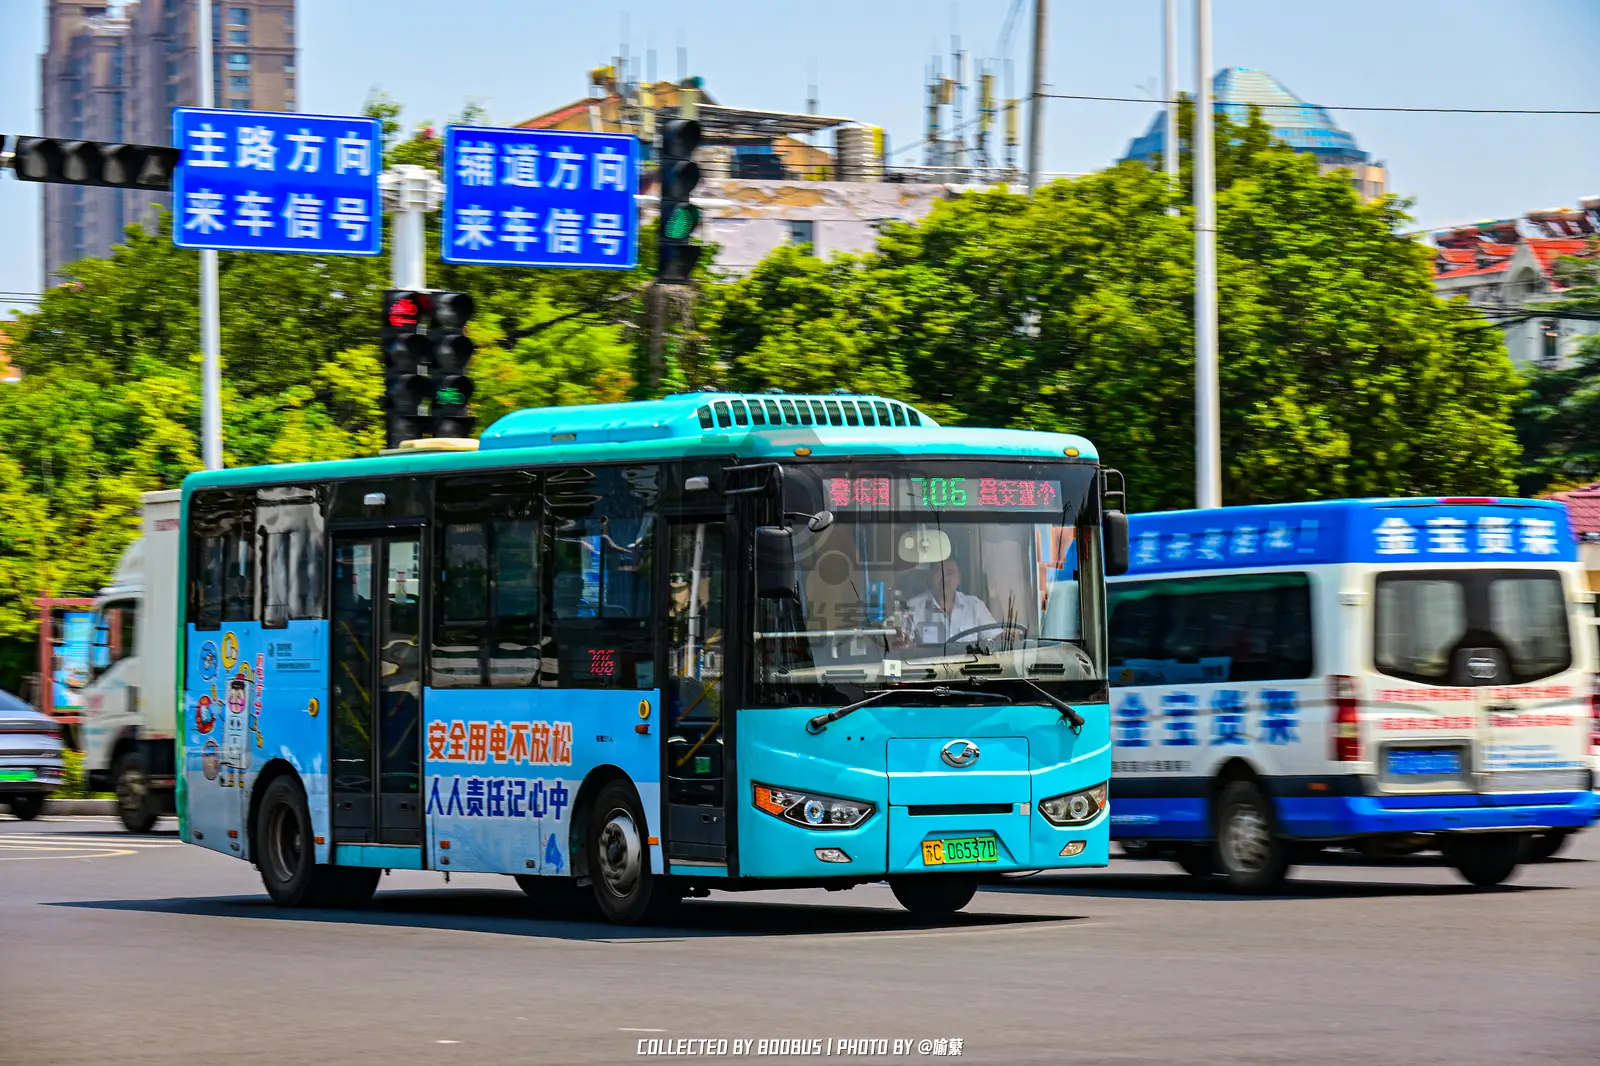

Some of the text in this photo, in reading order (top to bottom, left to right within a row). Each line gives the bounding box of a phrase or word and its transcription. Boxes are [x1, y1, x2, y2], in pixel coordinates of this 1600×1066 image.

[187, 124, 371, 176] 主路方向
[456, 140, 627, 192] 辅道方向
[184, 188, 371, 242] 来车信号
[454, 205, 627, 256] 来车信号
[911, 477, 968, 507] 706
[427, 721, 572, 765] 安全用电不放松
[426, 777, 569, 820] 人人责任记心中
